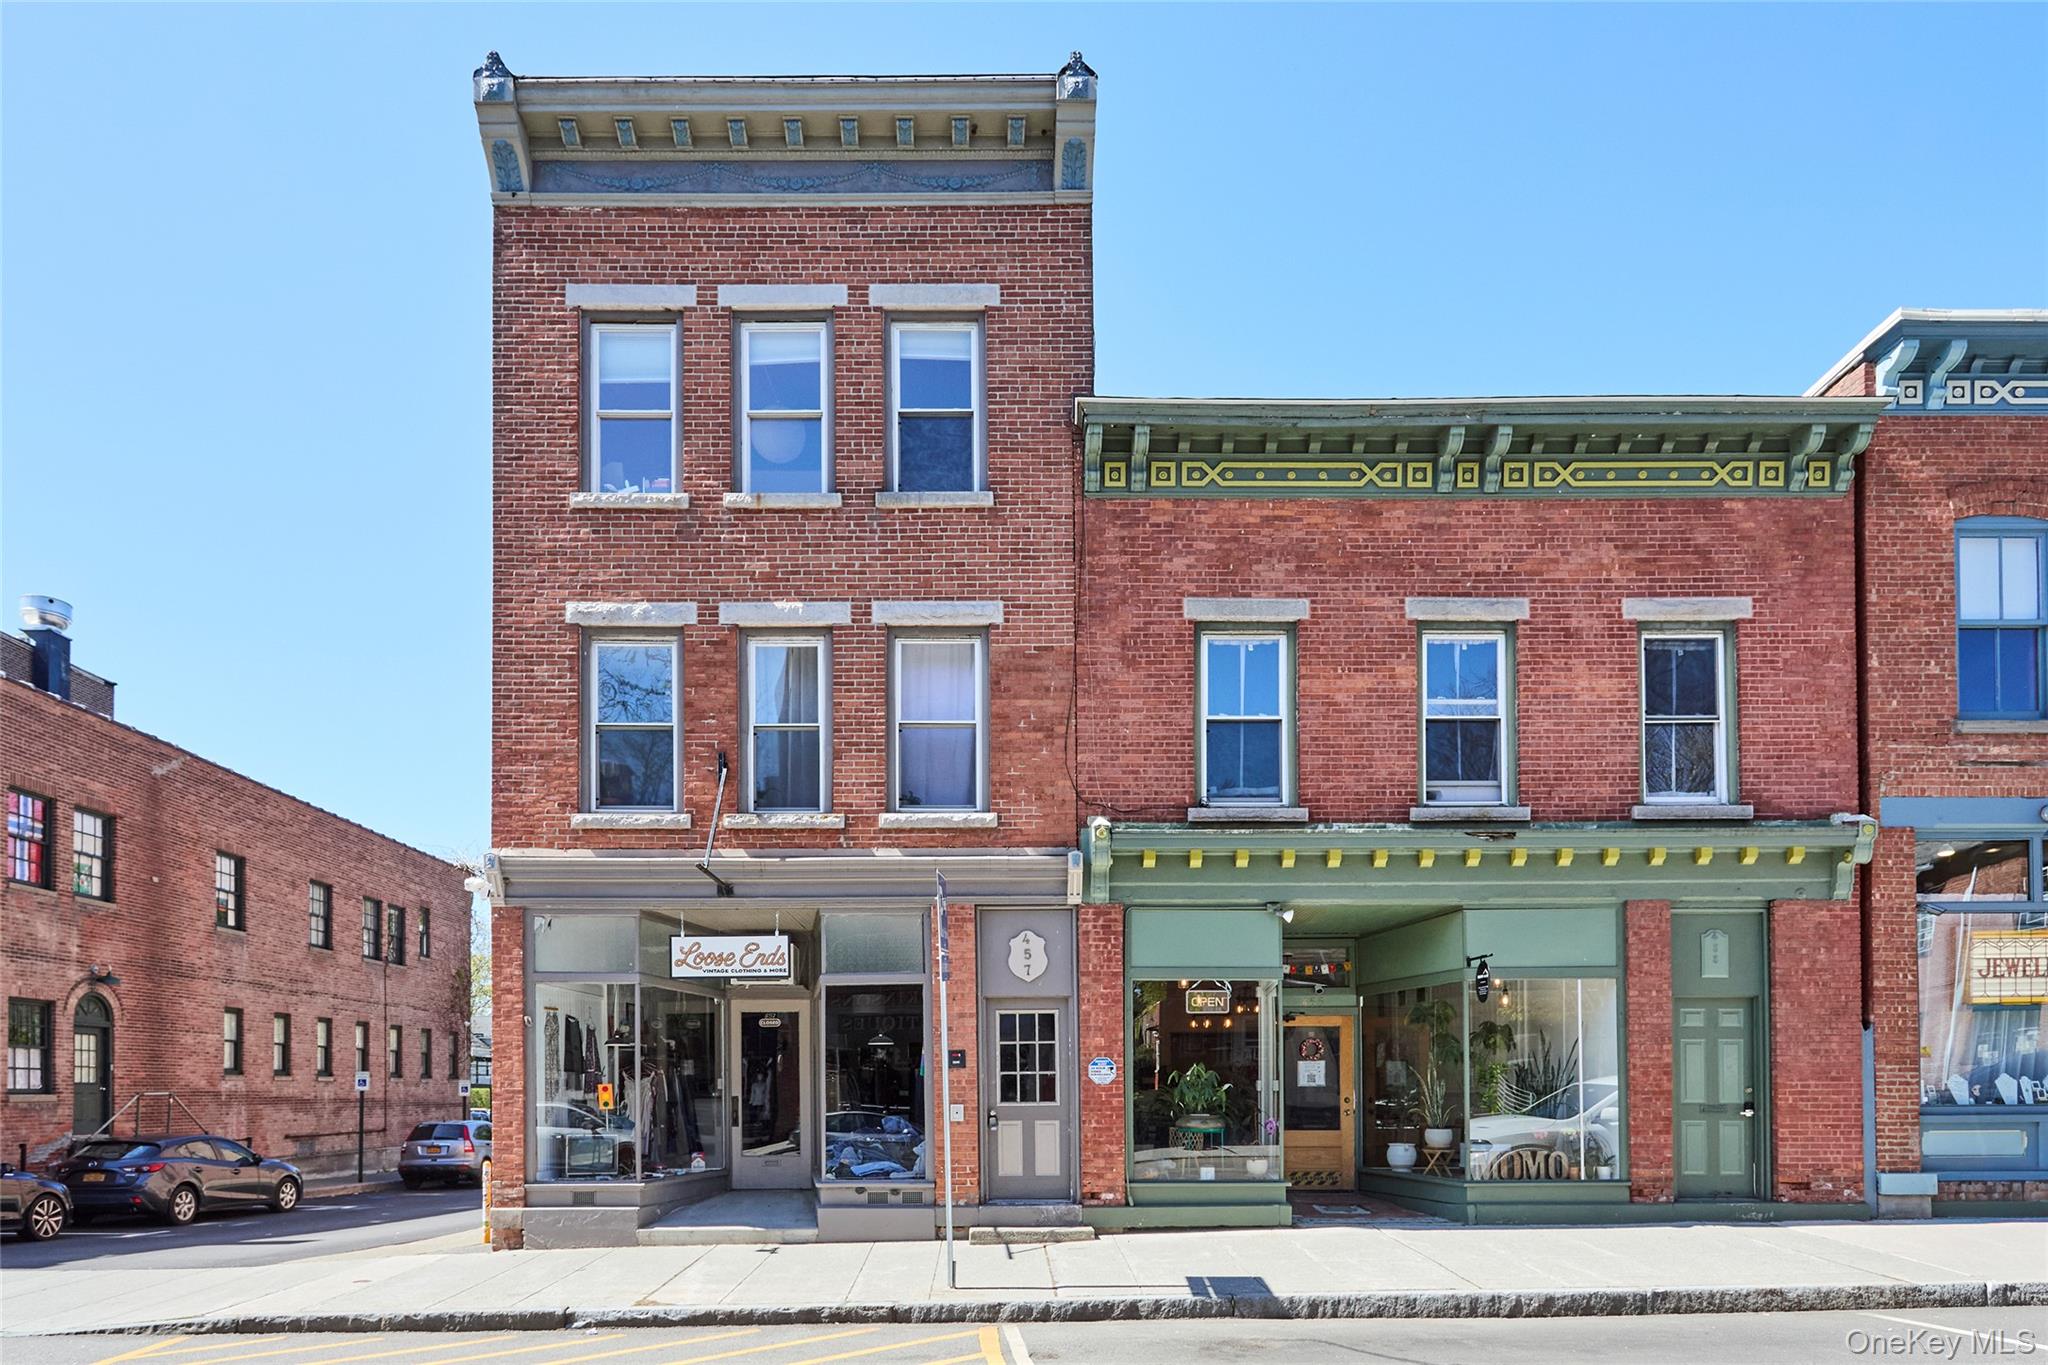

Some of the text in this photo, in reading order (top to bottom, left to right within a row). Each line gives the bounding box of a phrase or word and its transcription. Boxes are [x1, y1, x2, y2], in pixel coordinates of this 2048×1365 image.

[674, 941, 786, 971] Loose Ends
[1022, 933, 1032, 976] 457
[1976, 957, 2048, 978] JEWEL
[1191, 996, 1224, 1007] OPEN
[1470, 1151, 1569, 1180] MOMO
